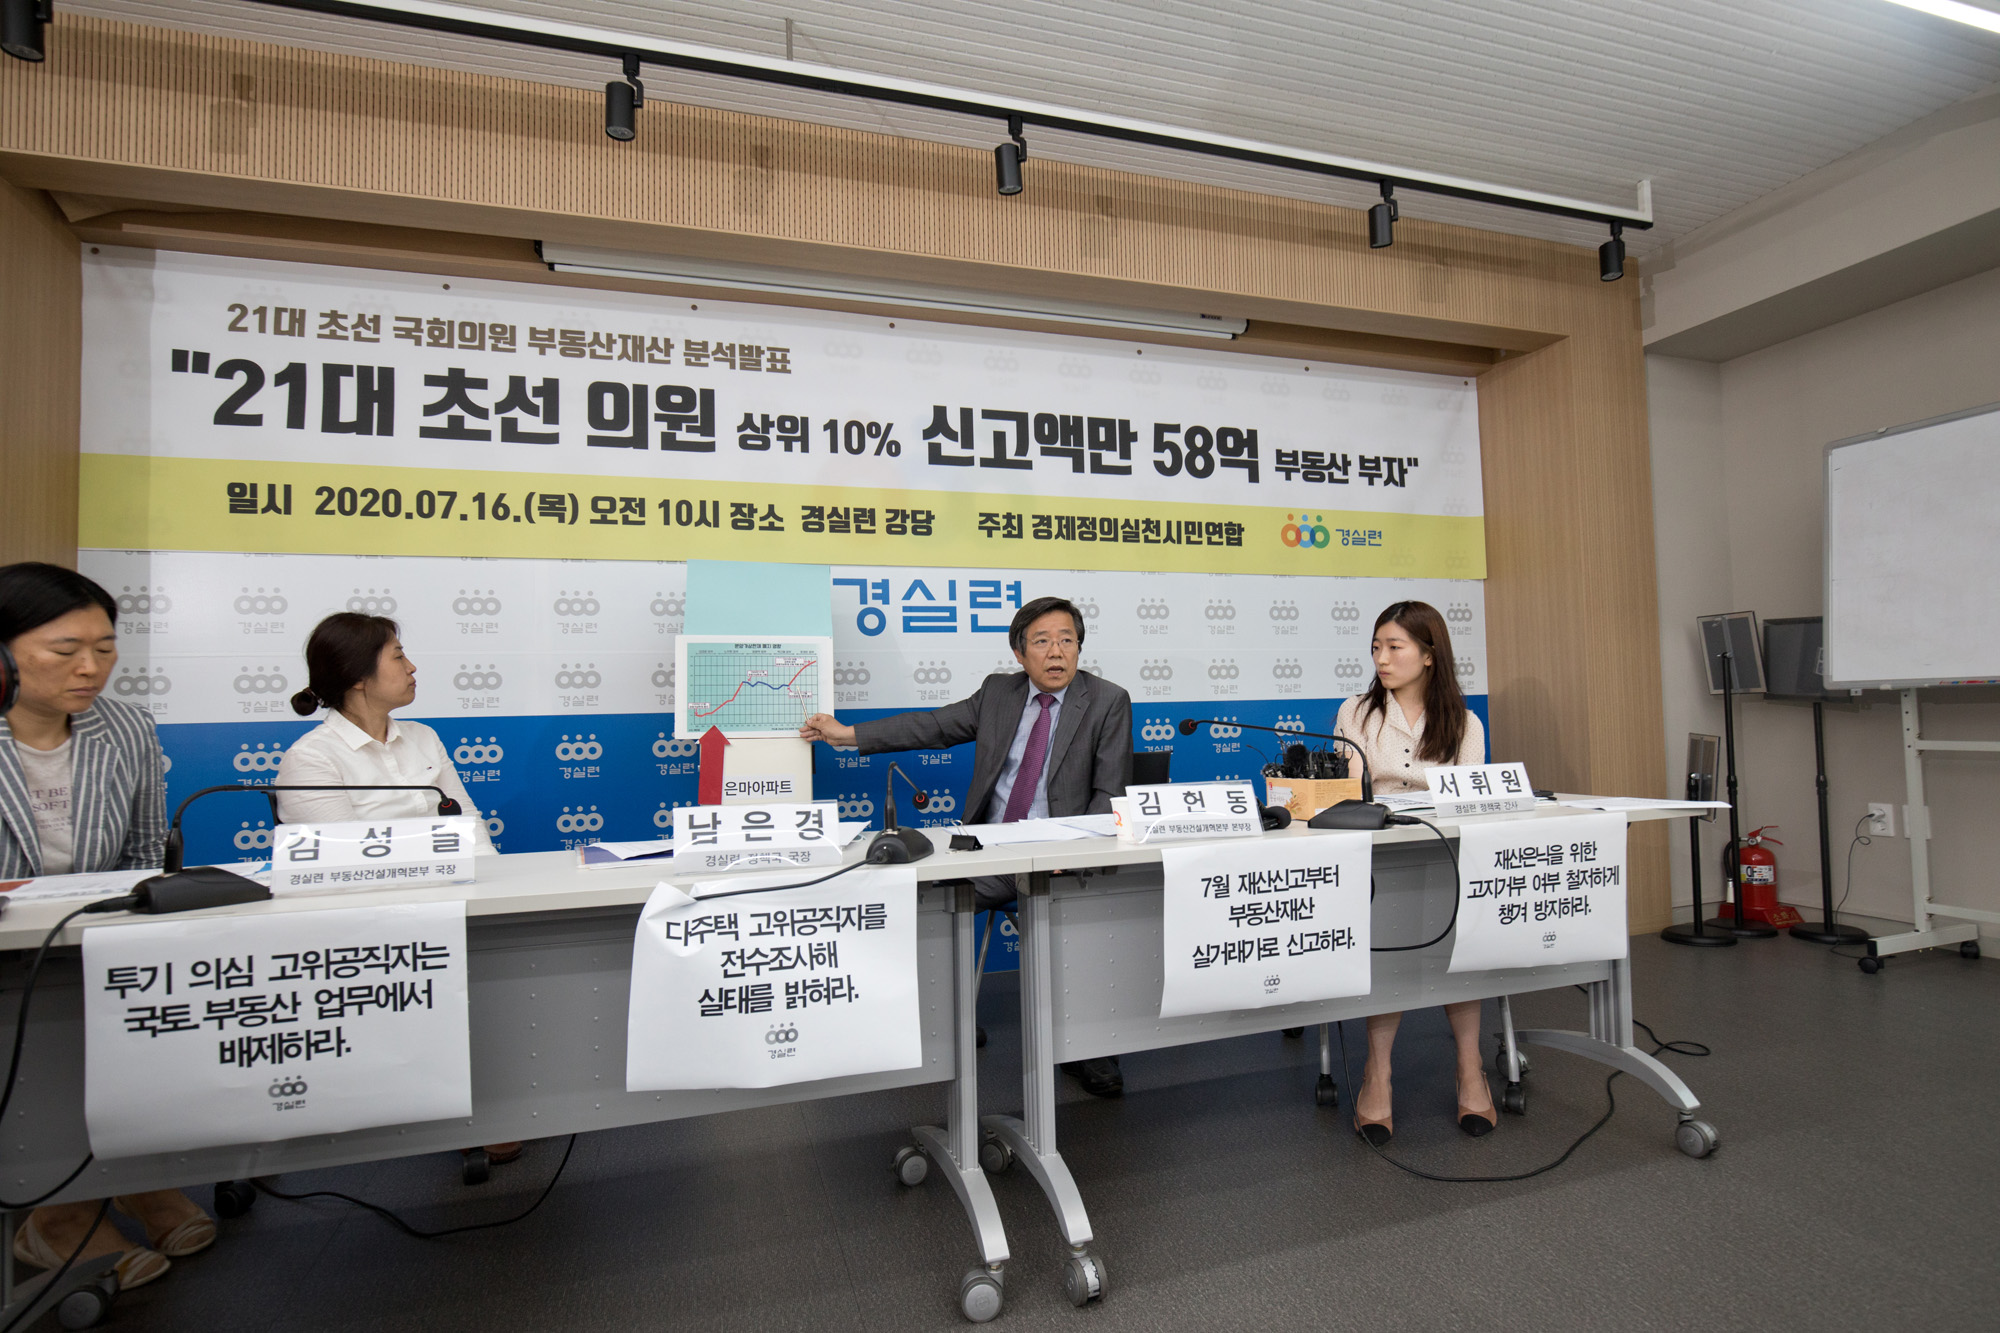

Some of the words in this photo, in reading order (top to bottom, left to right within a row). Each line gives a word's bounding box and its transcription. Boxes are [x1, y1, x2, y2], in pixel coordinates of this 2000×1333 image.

[227, 303, 306, 338] 21대
[317, 309, 382, 345] 초선
[392, 314, 517, 354] 국회의원
[527, 326, 673, 365] 부동산재산
[683, 339, 792, 374] 분석발표
[170, 347, 396, 438] "21대
[418, 366, 561, 445] 초선
[586, 380, 717, 452] 의원
[736, 412, 809, 454] 상위
[822, 418, 902, 458] 10%
[922, 404, 1137, 476] 신고액만
[1153, 421, 1260, 483] 58억
[1274, 448, 1350, 486] 부동산
[1357, 454, 1419, 488] 부자"
[226, 480, 293, 516] 일시
[314, 485, 579, 525] 2020.07.16.(목)
[589, 494, 646, 526] 오전
[658, 499, 719, 528] 10시
[729, 502, 785, 532] 장소
[801, 505, 877, 534] 경실련
[884, 509, 936, 537] 강당
[977, 512, 1023, 540] 주최
[1031, 513, 1245, 547] 경제정의실천시민연합
[1335, 528, 1382, 547] 경실련
[833, 578, 1022, 637] 경실련
[119, 621, 169, 635] 경실련
[238, 621, 285, 634] 경실련
[456, 622, 499, 634] 경실련
[557, 622, 598, 634] 경실련
[1139, 624, 1168, 635] 경실련
[1207, 625, 1236, 635] 경실련
[1272, 625, 1299, 635] 경실련
[1333, 626, 1359, 636] 경실련
[1448, 626, 1472, 636] 경실련
[1142, 686, 1171, 696] 경실련
[1211, 684, 1239, 695] 경실련
[1275, 684, 1302, 694] 경실련
[1337, 682, 1362, 692] 경실련
[558, 695, 598, 707] 경실련
[834, 691, 869, 702] 경실련
[916, 690, 950, 701] 경실련
[238, 700, 285, 713] 경실련
[457, 697, 500, 709] 경실련
[1212, 743, 1241, 754] 경실련
[835, 756, 870, 768] 경실련
[918, 754, 952, 765] 경실련
[559, 766, 600, 779] 경실련
[656, 763, 694, 775] 경실련
[458, 769, 500, 783] 경실련
[724, 780, 792, 796] 은마아파트
[32, 800, 70, 812] SOFT
[1455, 804, 1476, 814] 경실련
[1480, 802, 1501, 811] 정책국
[1504, 801, 1518, 810] 간사
[1169, 823, 1229, 834] 부동산건설개혁본부
[1231, 822, 1251, 832] 본부장
[705, 854, 741, 867] 경실련
[788, 850, 811, 863] 국장
[1494, 844, 1564, 870] 재산은닉을
[1569, 840, 1598, 863] 위한
[290, 873, 324, 885] 경실련
[330, 866, 429, 882] 부동산건설개혁본부
[435, 864, 456, 875] 국장
[1201, 874, 1231, 899] 7월
[1238, 864, 1340, 894] 재산신고부터
[1466, 874, 1527, 900] 고지거부
[1531, 871, 1561, 895] 여부
[1565, 864, 1620, 892] 철저하게
[1228, 896, 1315, 929] 부동산재산
[1498, 902, 1527, 924] 챙겨
[1533, 894, 1592, 922] 방지하라.
[665, 912, 740, 947] 다주택
[748, 902, 887, 937] 고위공직자를
[1192, 935, 1280, 970] 실거래가로
[1286, 927, 1356, 957] 신고하라.
[720, 941, 838, 979] 전수조사해
[104, 962, 173, 999] 투기
[188, 954, 254, 992] 의심
[268, 941, 450, 983] 고위공직자는
[313, 978, 434, 1020] 업무에서
[697, 981, 774, 1018] 실태를
[785, 975, 860, 1009] 밝혀라.
[219, 1026, 352, 1068] 배제하라.
[767, 1047, 796, 1059] 경실련
[272, 1099, 306, 1112] 경실련
